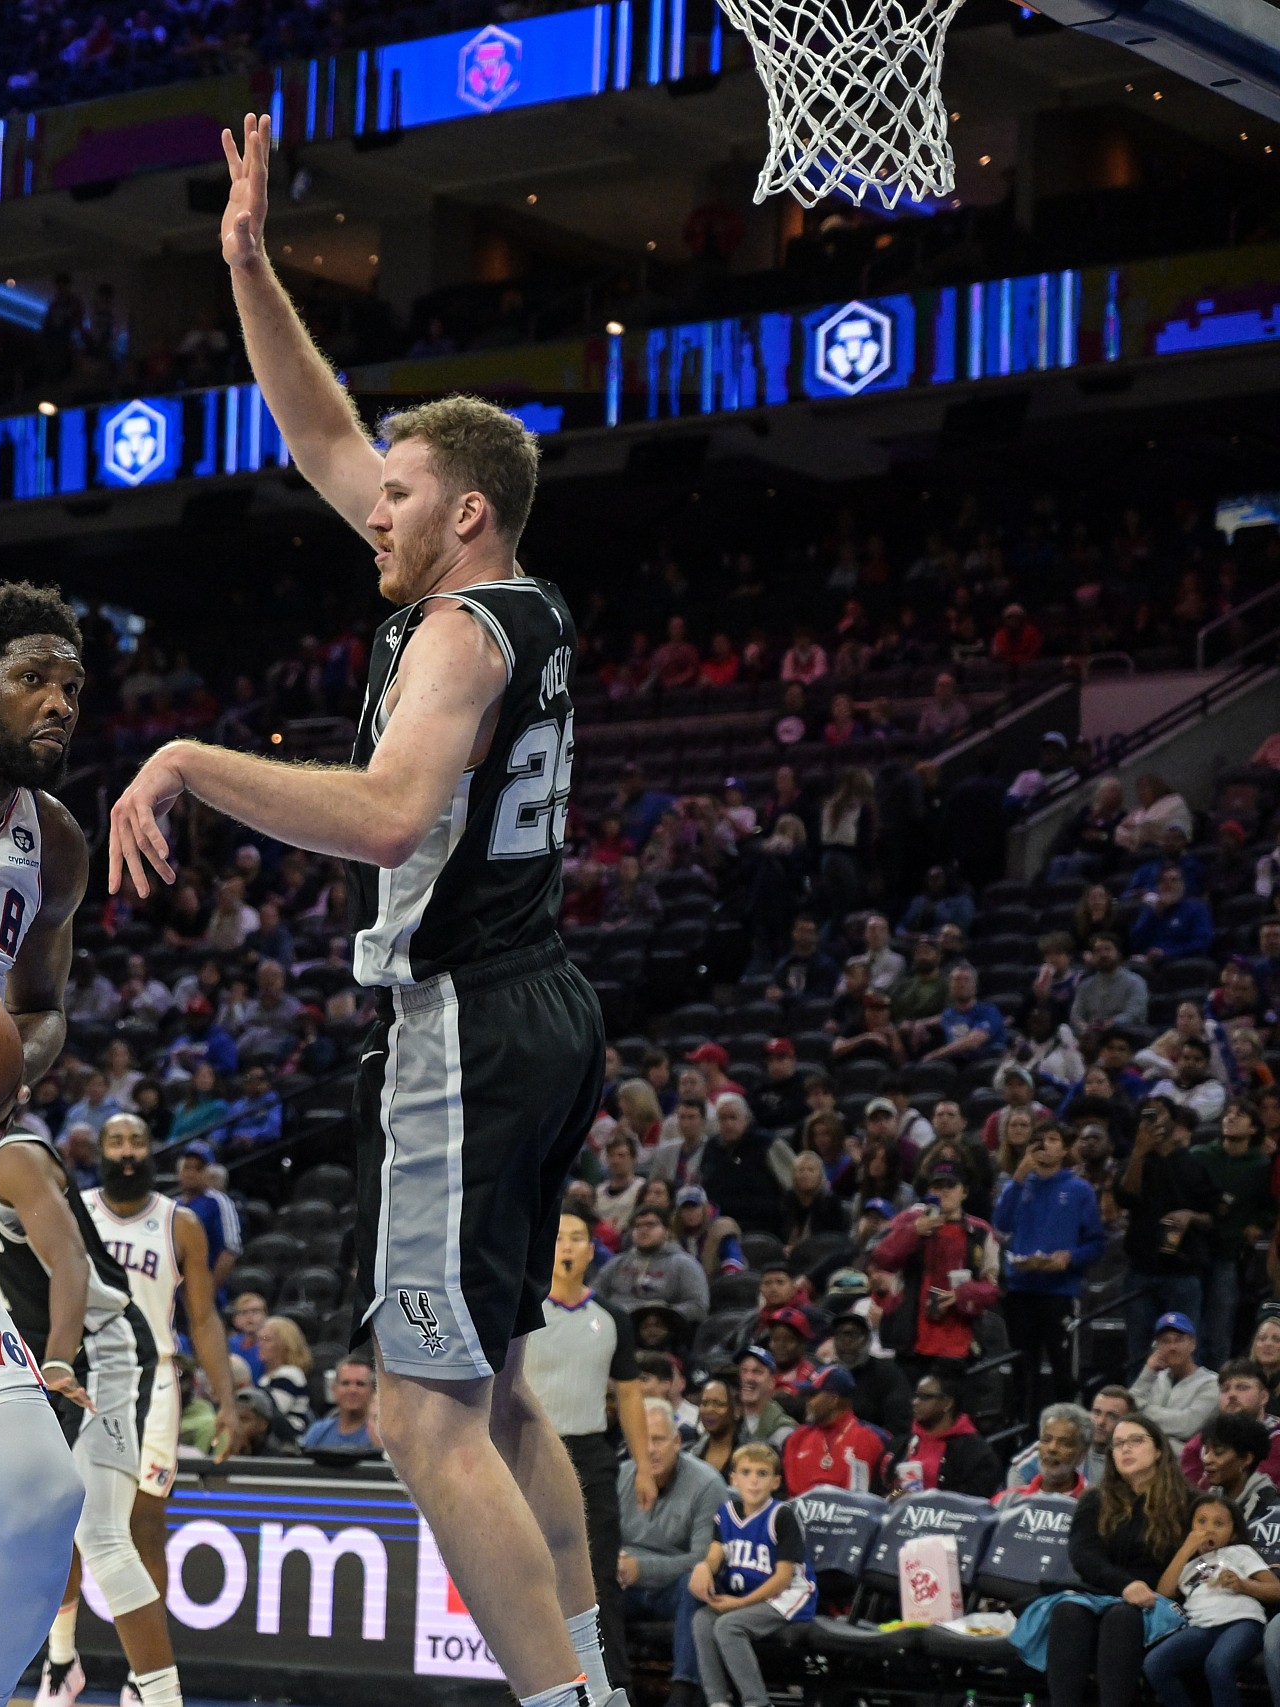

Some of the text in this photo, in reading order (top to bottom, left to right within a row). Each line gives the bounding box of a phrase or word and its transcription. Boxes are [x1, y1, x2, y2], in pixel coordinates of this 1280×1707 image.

[794, 1499, 836, 1524] NJM
[900, 1505, 946, 1530] NJM
[1016, 1507, 1065, 1533] NJM
[1252, 1522, 1280, 1547] NJ
